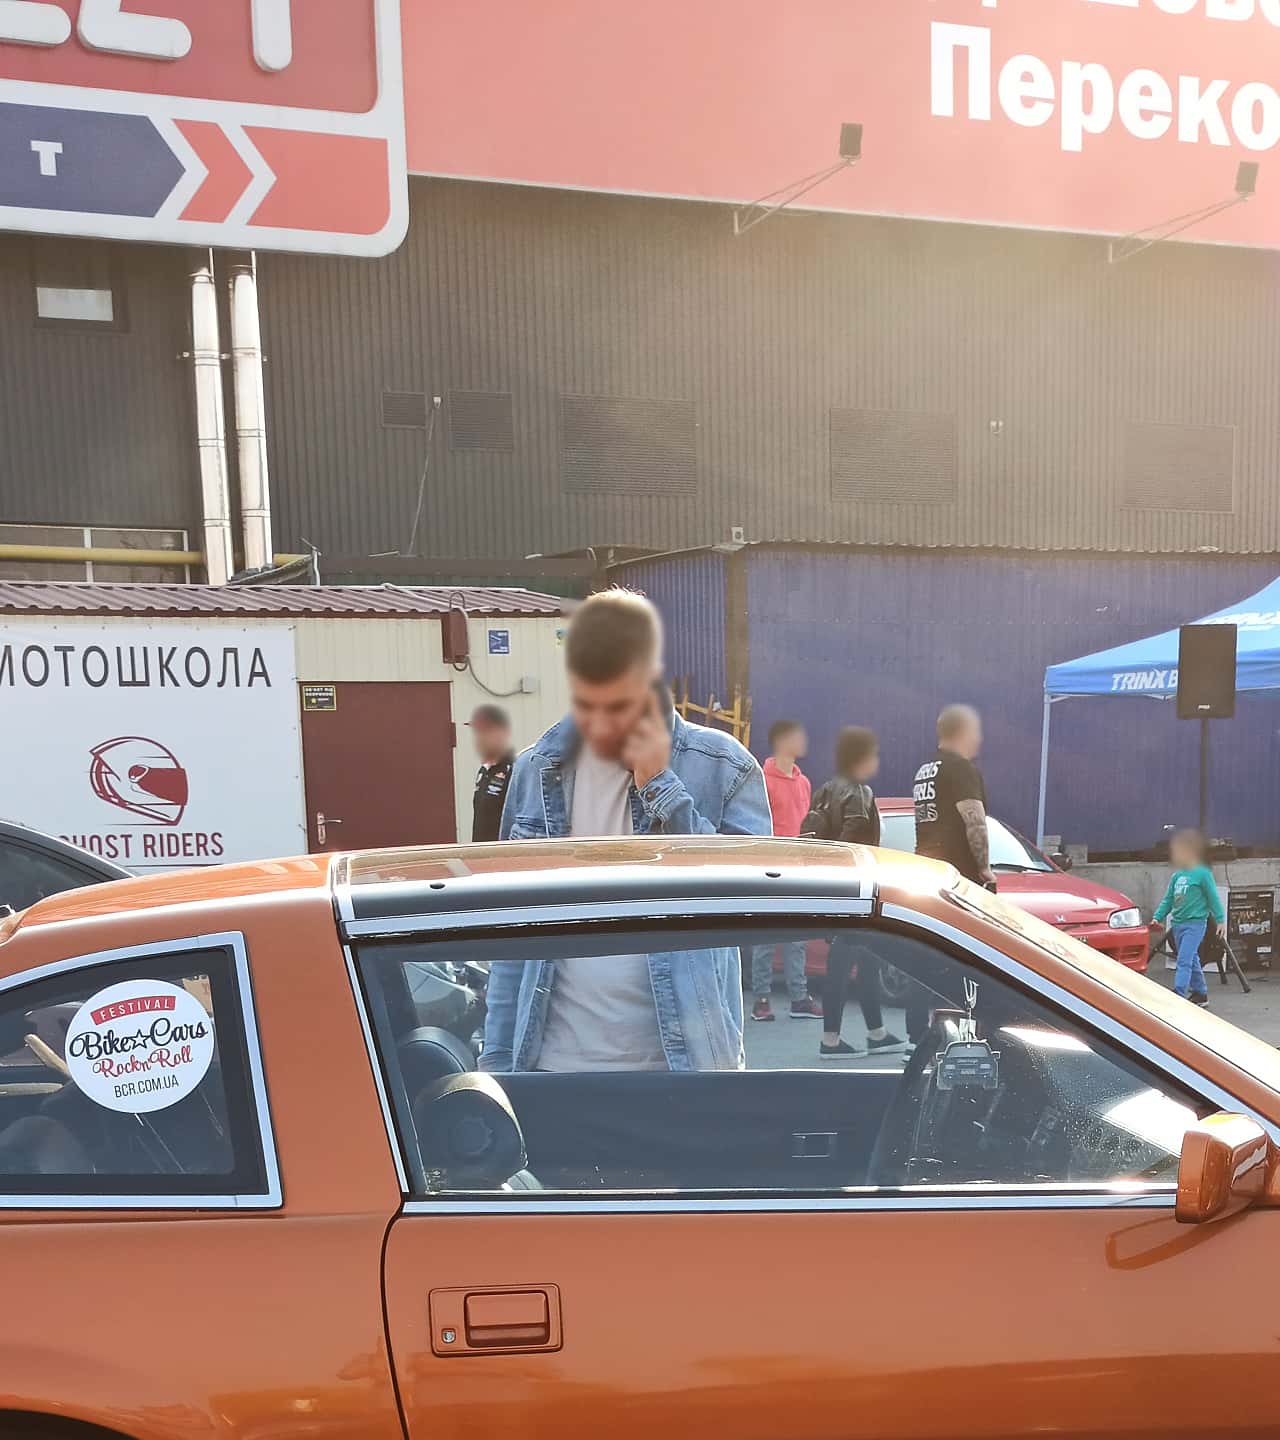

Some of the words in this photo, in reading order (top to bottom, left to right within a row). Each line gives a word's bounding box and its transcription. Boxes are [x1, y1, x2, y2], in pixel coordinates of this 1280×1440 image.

[1111, 668, 1168, 691] TRINX
[143, 832, 225, 858] RIDERS
[100, 999, 170, 1021] FESTIVAL
[113, 1074, 179, 1098] BCR.COM.UA
